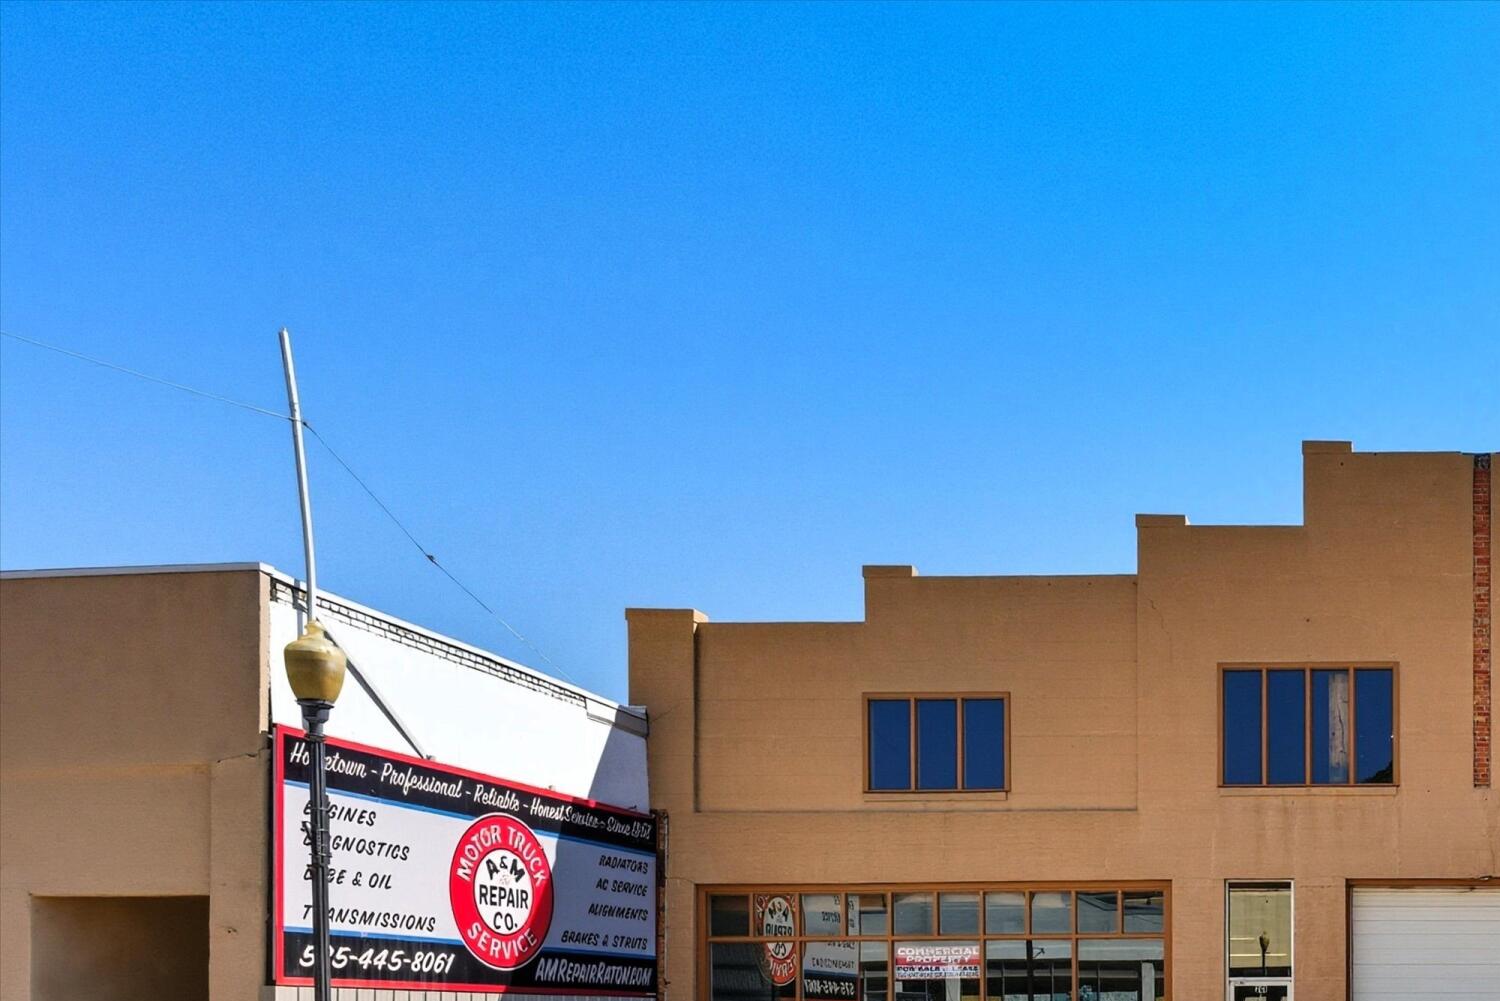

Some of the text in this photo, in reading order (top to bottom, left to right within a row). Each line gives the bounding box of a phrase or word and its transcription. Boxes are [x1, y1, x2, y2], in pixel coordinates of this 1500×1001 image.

[290, 742, 367, 778] Hoetown
[381, 763, 463, 798] Professional
[474, 784, 520, 811] Reliable
[530, 797, 565, 821] Honest
[303, 799, 377, 827] EGINES
[303, 829, 410, 861] GNOSTICS
[456, 824, 546, 887] MOTOR TRUCK
[303, 866, 392, 890] LBE & OIL
[599, 855, 648, 875] RADIATORS
[479, 884, 529, 910] REPAIR
[596, 878, 648, 897] AC SERVICE
[302, 904, 436, 932] TANSMISSIONS
[493, 911, 518, 931] CO.
[588, 903, 648, 921] ALIGNMENTS
[467, 922, 538, 960] SERVICE
[561, 930, 600, 946] BRAKES
[612, 935, 648, 951] STRUTS
[897, 946, 980, 956] COMMERCIAL
[299, 945, 455, 974] 55-445-8061
